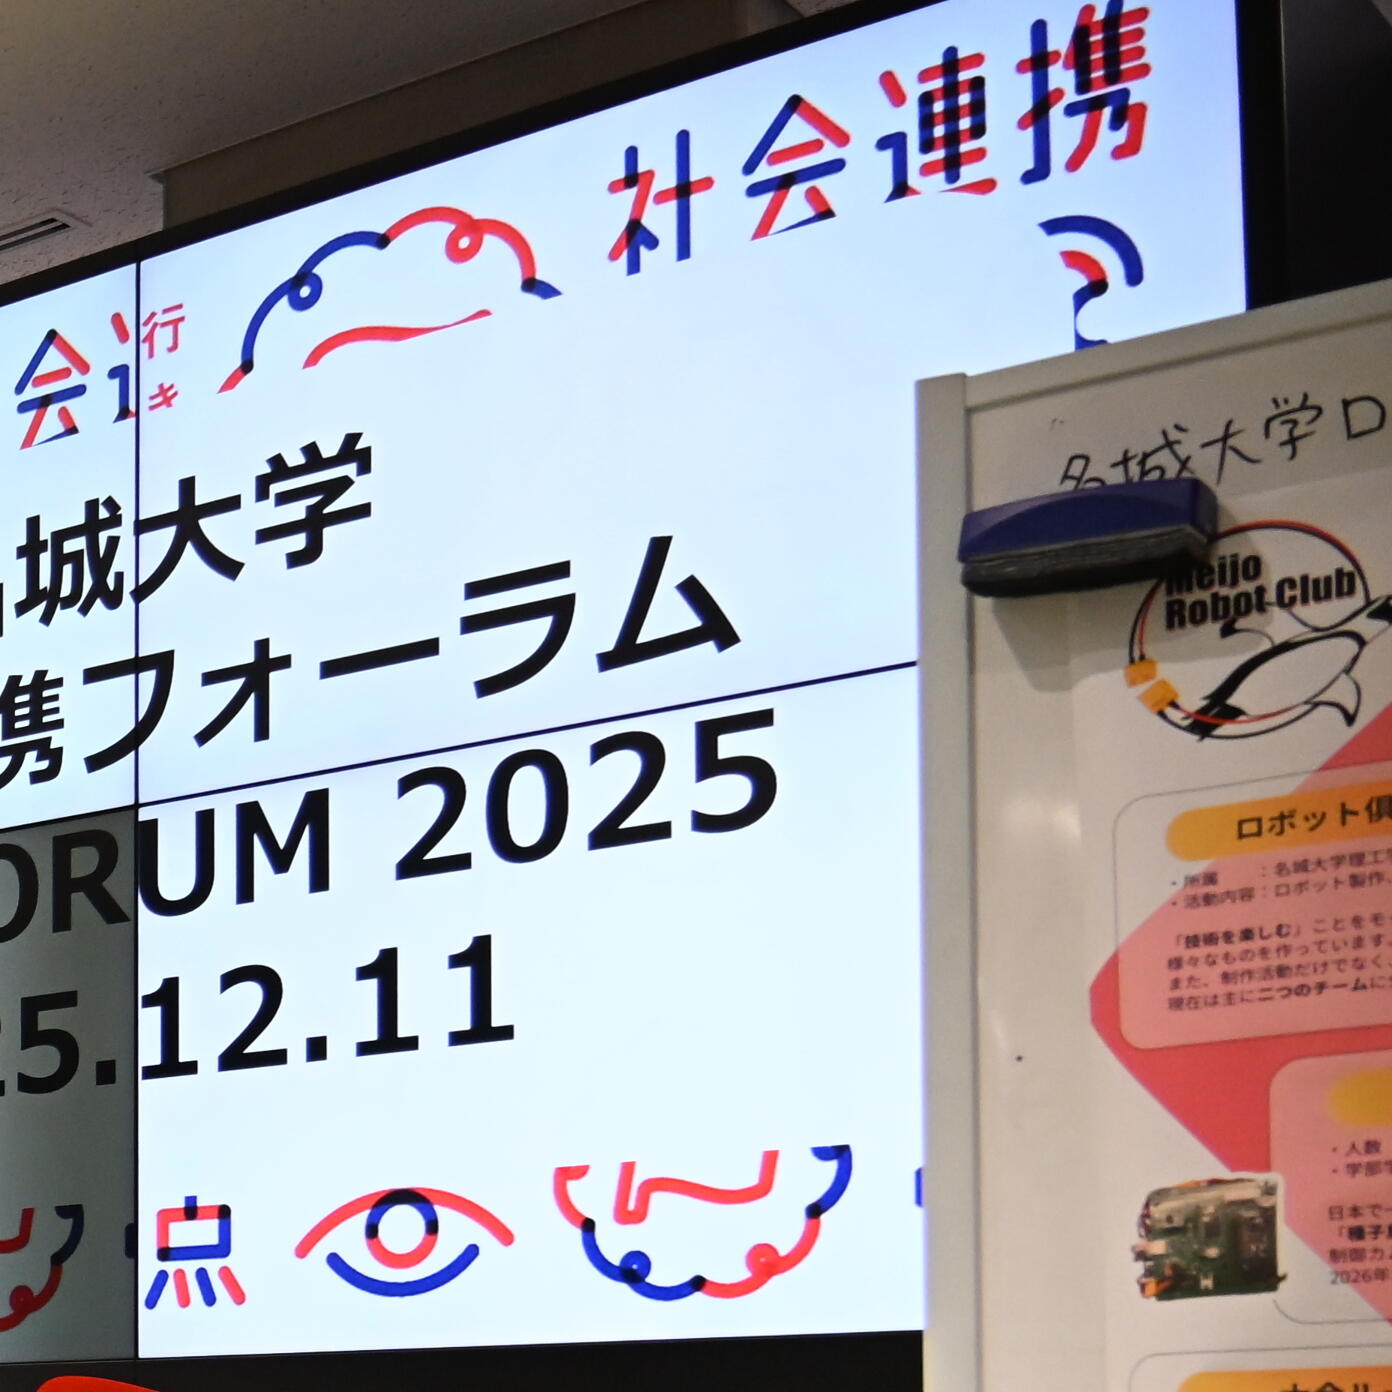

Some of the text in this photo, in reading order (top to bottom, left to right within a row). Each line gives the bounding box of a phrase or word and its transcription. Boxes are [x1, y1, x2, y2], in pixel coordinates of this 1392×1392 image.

[607, 0, 1151, 276] 社会連携
[1164, 552, 1262, 598] Meijo
[1165, 566, 1357, 632] Robot Club
[395, 707, 778, 880] 2025
